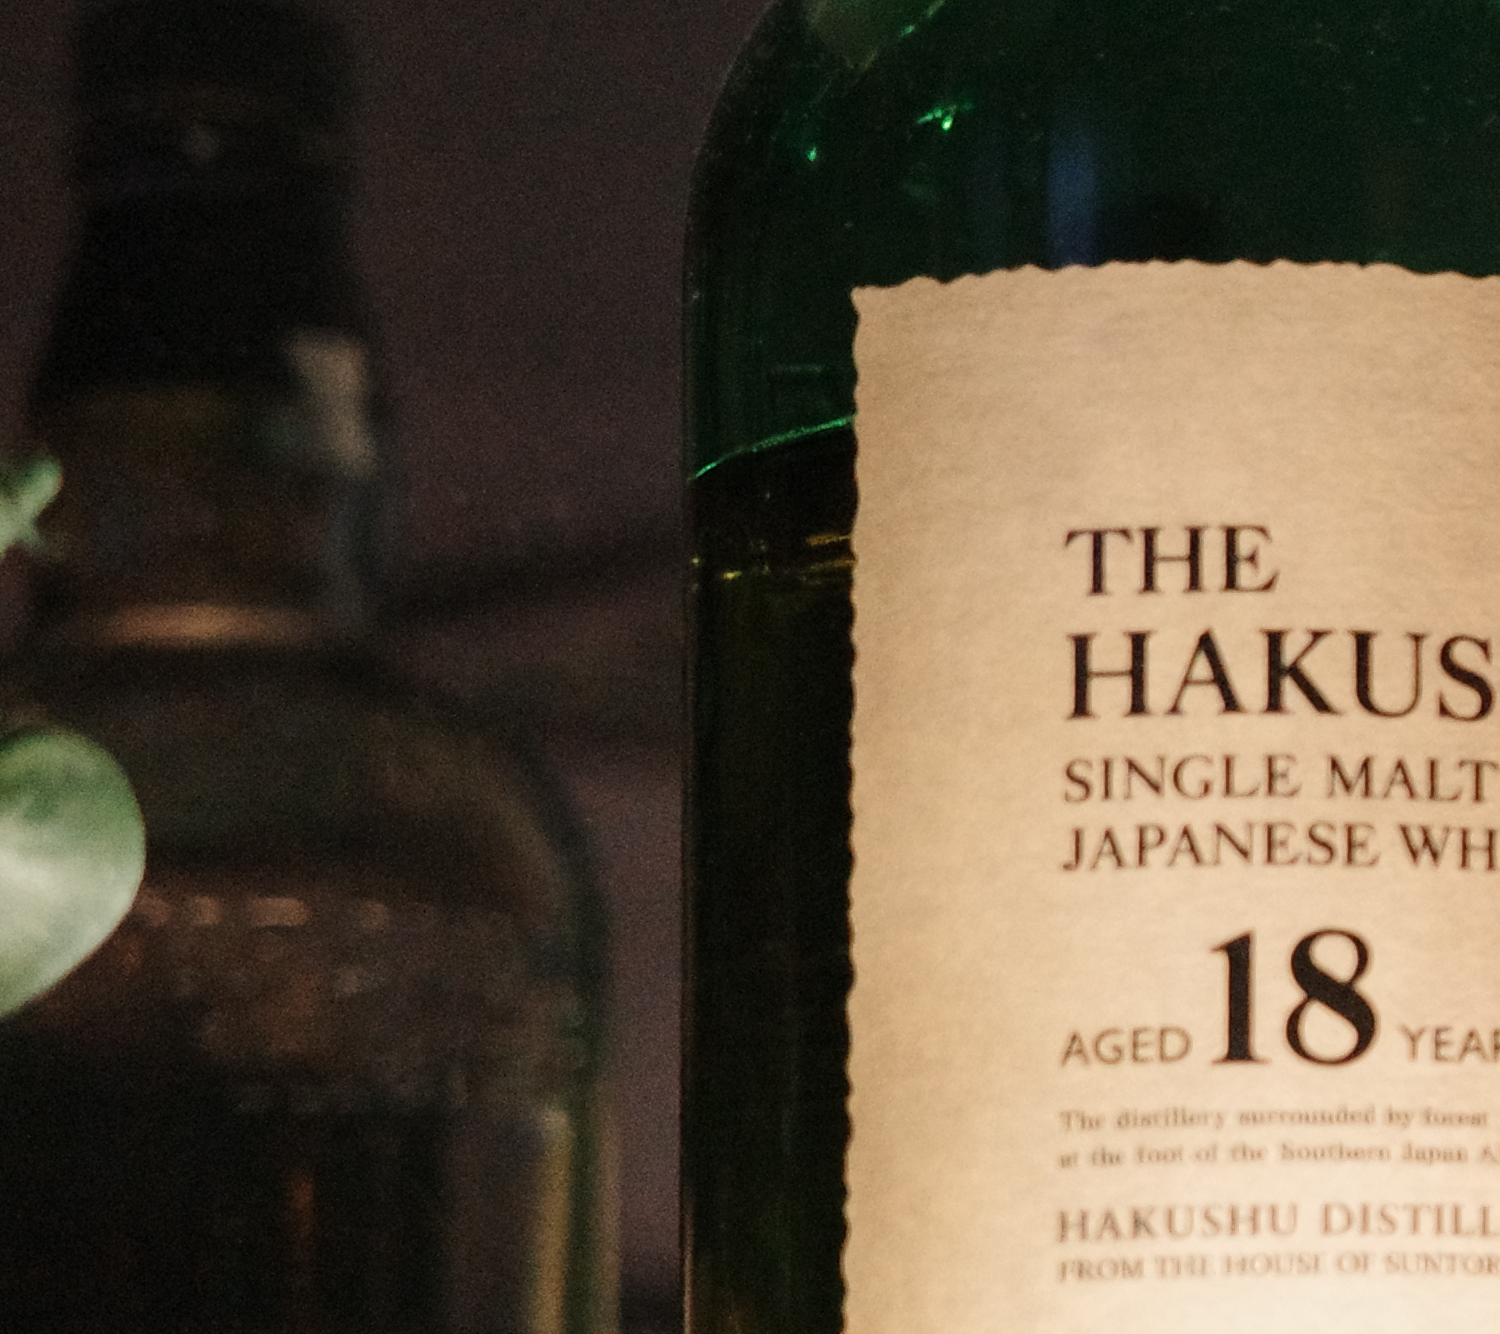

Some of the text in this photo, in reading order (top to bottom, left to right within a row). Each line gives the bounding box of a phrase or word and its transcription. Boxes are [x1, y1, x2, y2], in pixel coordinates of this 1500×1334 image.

[1065, 525, 1280, 596] THE
[1064, 753, 1500, 804] SINGLE MALT
[1063, 821, 1380, 871] JAPANESE
[1061, 1026, 1192, 1066] AGED
[1210, 928, 1378, 1066] 18
[1059, 1105, 1488, 1131] The distillery surrounded by forest
[1058, 1147, 1078, 1169] at
[1090, 1145, 1124, 1168] the
[1136, 1143, 1185, 1166] foot
[1194, 1141, 1220, 1165] of
[1228, 1141, 1266, 1165] the
[1279, 1140, 1390, 1163] Southern
[1401, 1140, 1468, 1168] Japan
[1057, 1202, 1299, 1243] HAKUSHU
[1057, 1255, 1144, 1283] FROM
[1153, 1253, 1210, 1279] THE
[1222, 1251, 1324, 1278] HOUSE
[1334, 1251, 1375, 1277] OF
